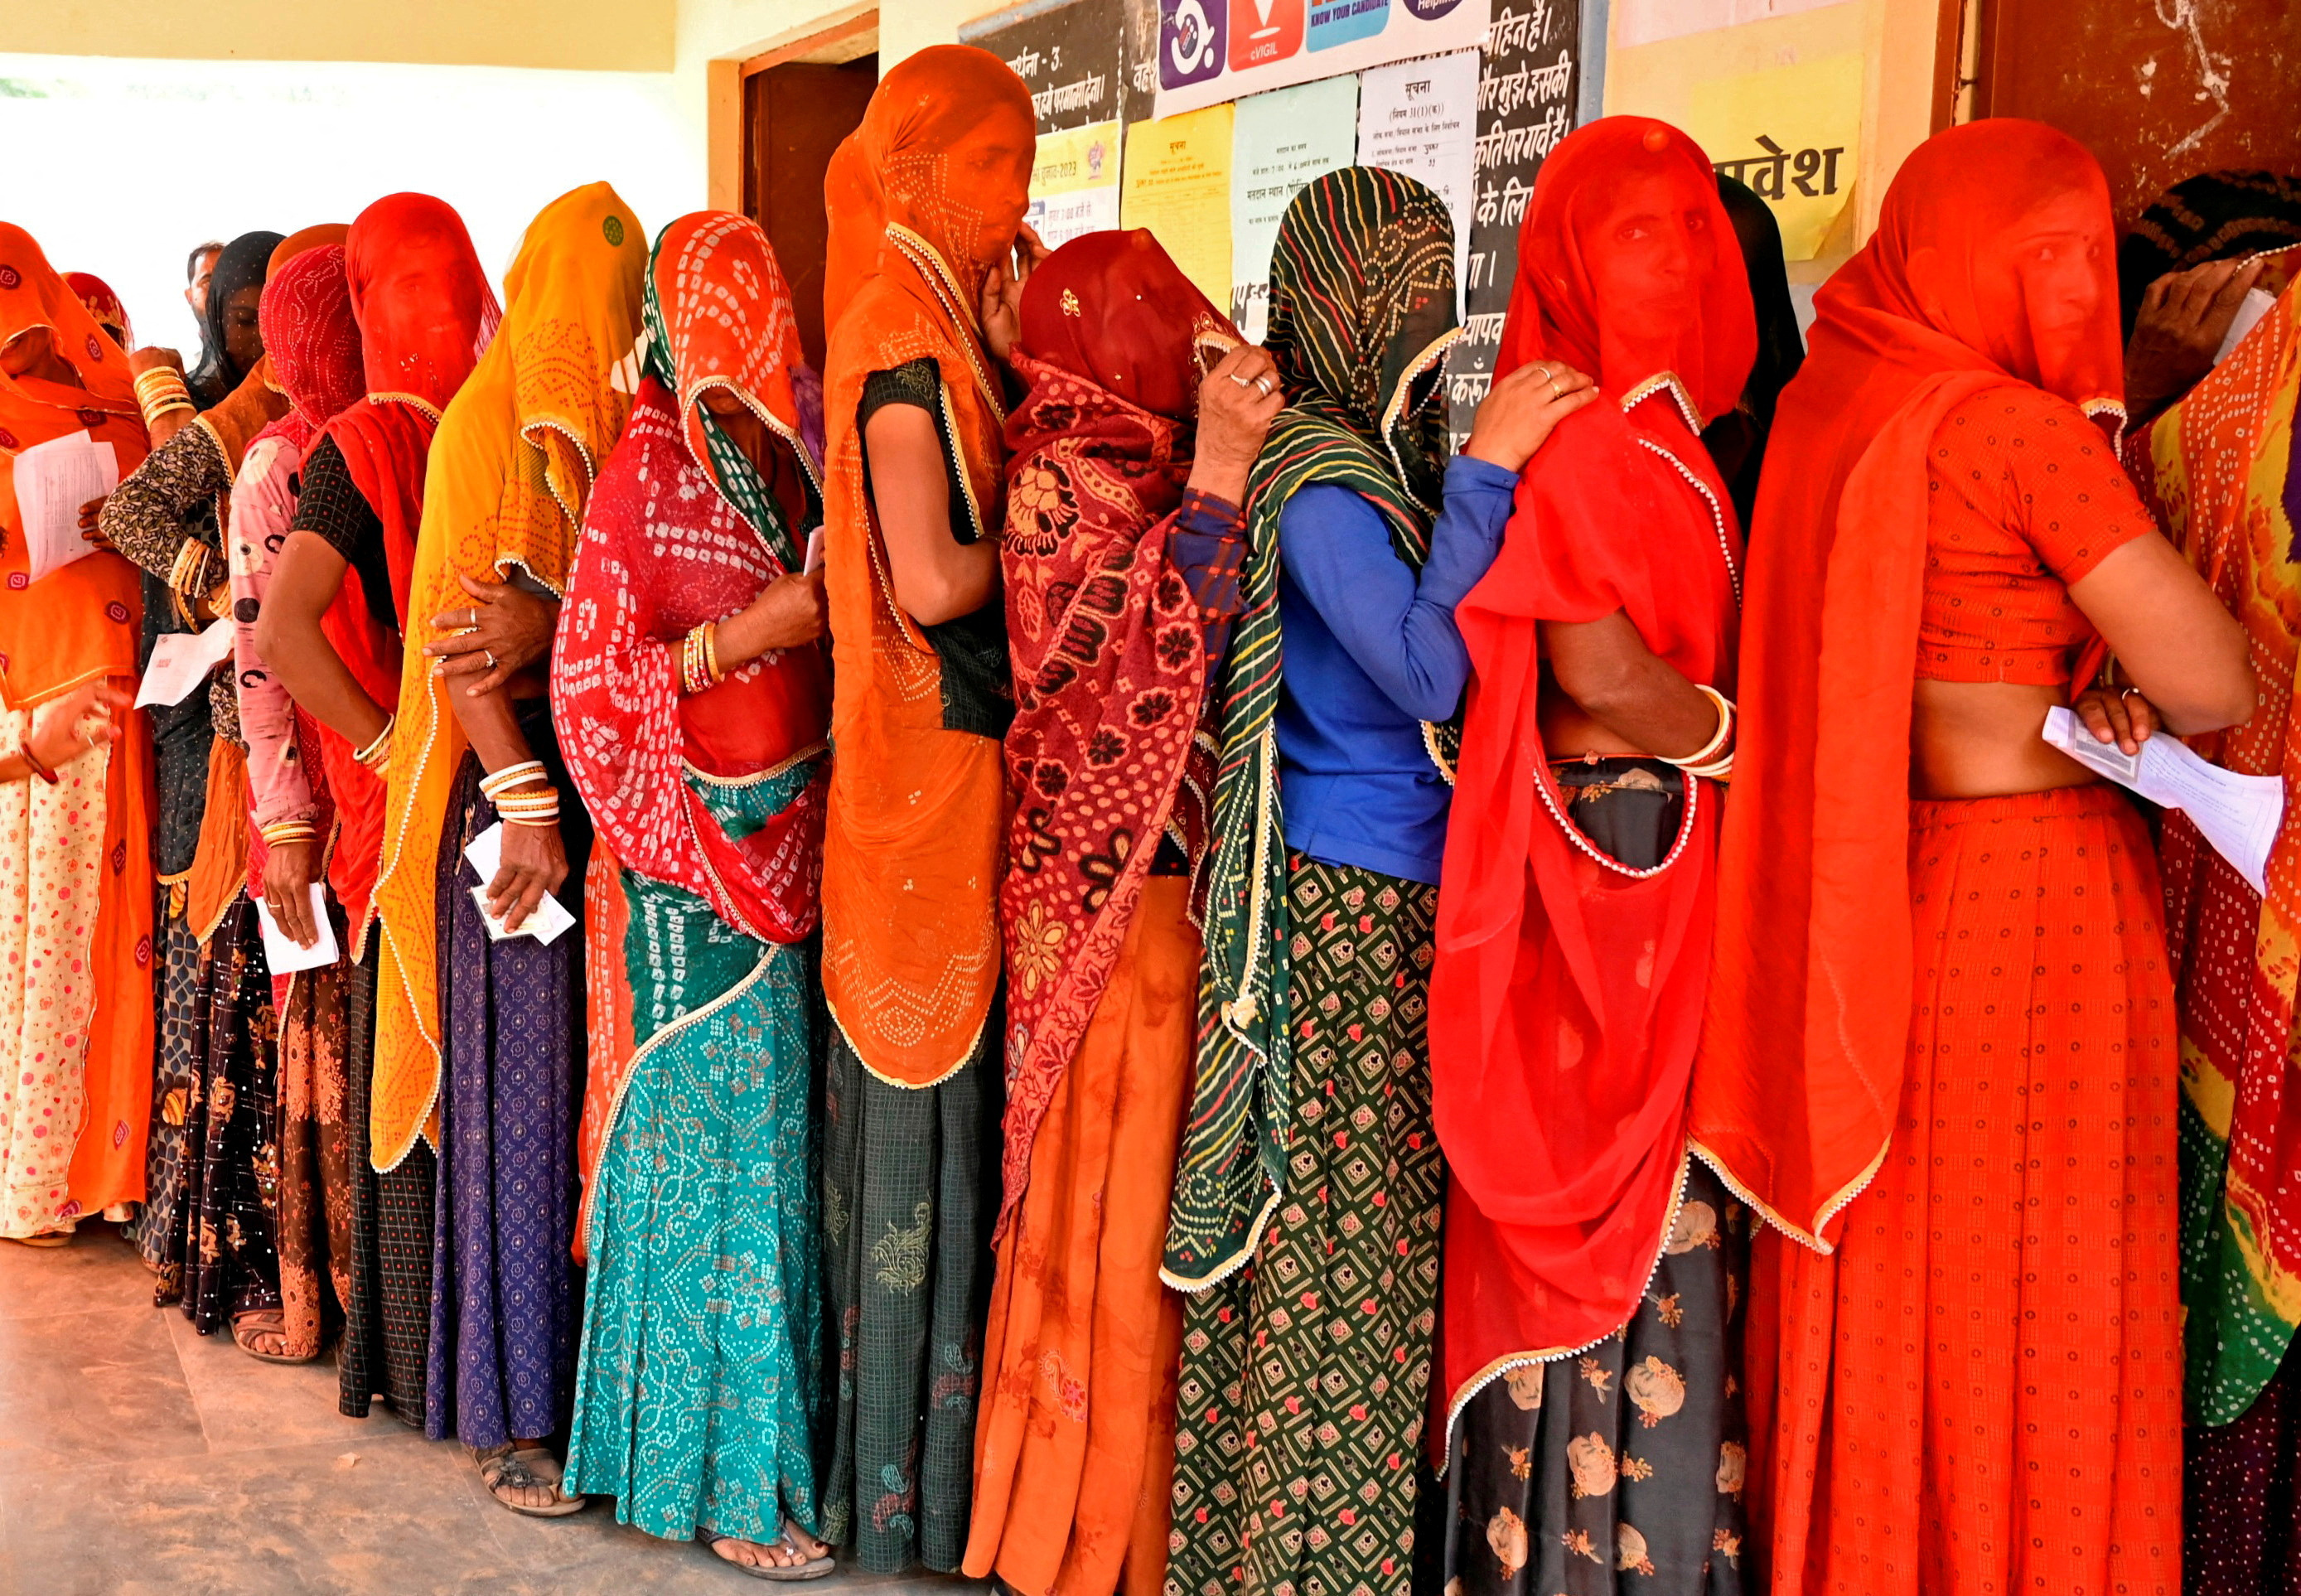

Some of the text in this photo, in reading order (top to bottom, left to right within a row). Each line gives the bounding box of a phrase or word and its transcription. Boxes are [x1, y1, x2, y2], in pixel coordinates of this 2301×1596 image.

[1311, 10, 1331, 27] KNOW
[1332, 5, 1351, 21] YOUR
[1351, 0, 1388, 16] CANDIDATE
[1418, 0, 1456, 11] Helplin
[1006, 46, 1040, 79] ार्थना
[1250, 43, 1278, 60] cVIGIL
[1405, 80, 1431, 100] सूचना
[1498, 60, 1529, 116] मुझे
[1527, 49, 1572, 109] इसकी
[1504, 128, 1525, 165] पर
[1523, 106, 1551, 161] गर्व
[1477, 180, 1499, 228] के
[1500, 177, 1534, 227] लि
